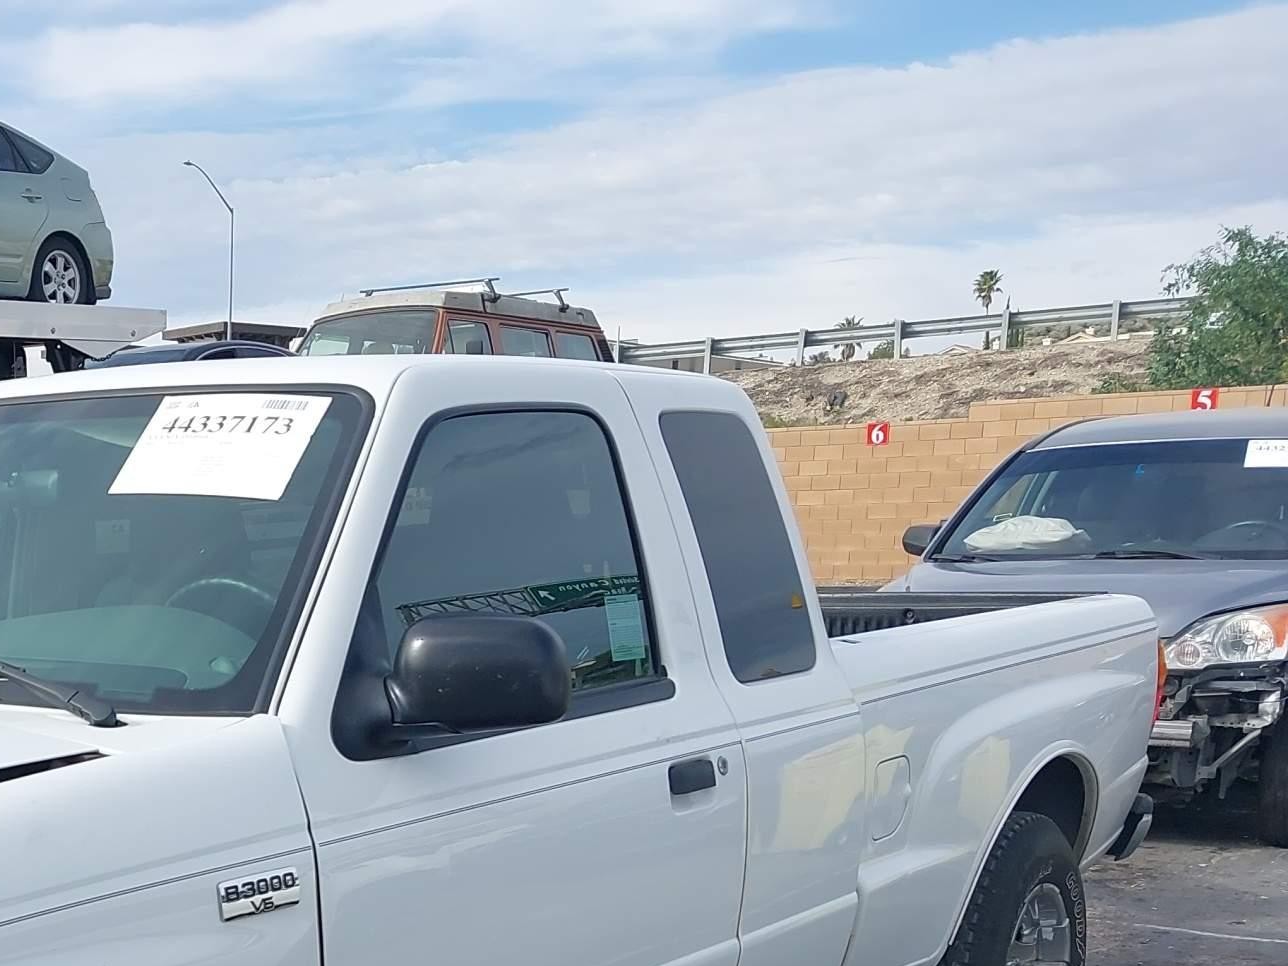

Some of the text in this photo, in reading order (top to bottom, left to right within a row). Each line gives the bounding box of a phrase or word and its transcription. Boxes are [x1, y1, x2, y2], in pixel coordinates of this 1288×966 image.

[1196, 390, 1212, 411] 5
[162, 415, 294, 435] 44337173
[871, 424, 885, 444] 6
[222, 871, 297, 903] B3000
[250, 896, 276, 914] V6
